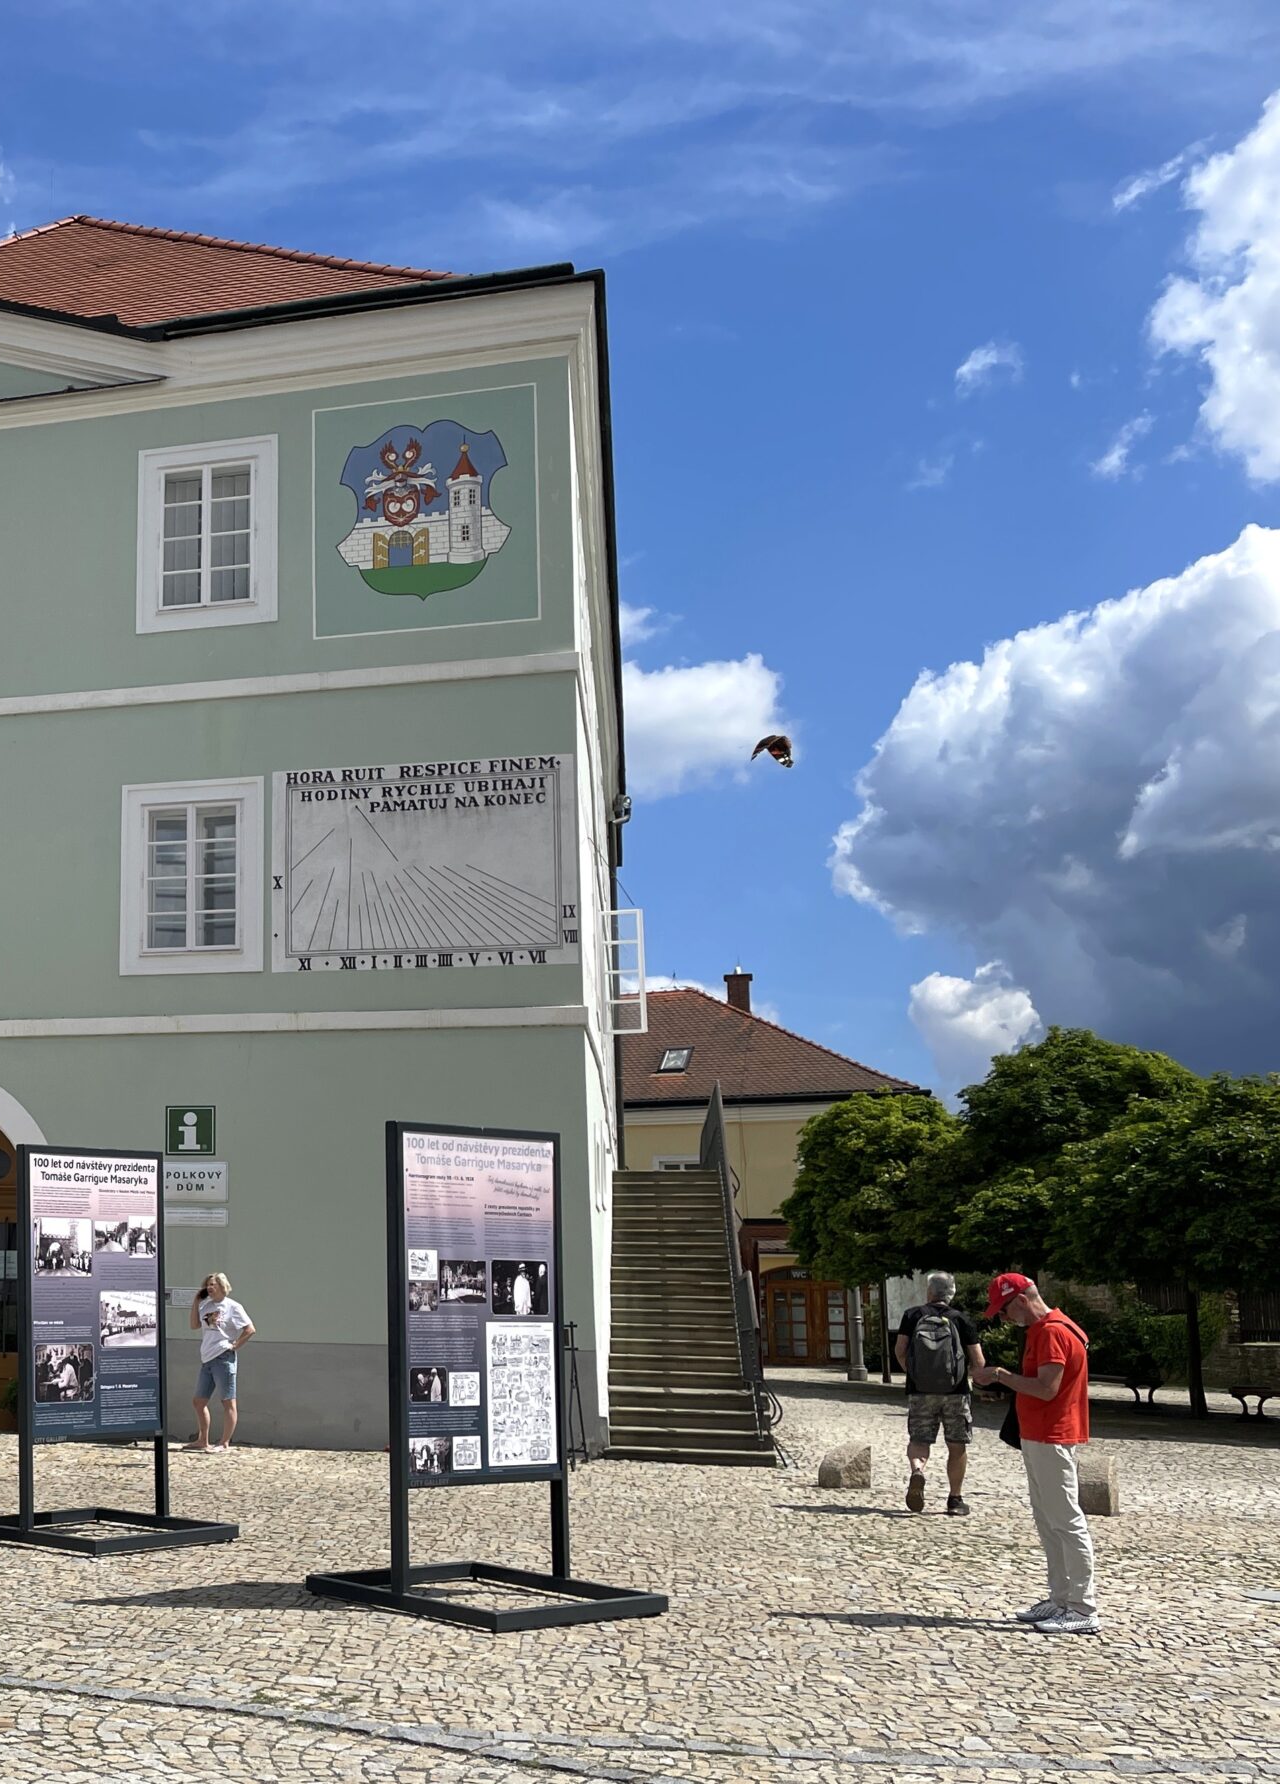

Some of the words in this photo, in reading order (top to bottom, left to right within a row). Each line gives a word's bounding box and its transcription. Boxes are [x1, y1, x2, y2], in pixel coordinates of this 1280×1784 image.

[286, 771, 335, 785] HORA
[341, 767, 385, 782] RUIT
[399, 760, 481, 779] RESPICE
[300, 787, 373, 802] HODINY
[381, 782, 455, 798] RYCHLE
[369, 797, 448, 813] PAMATUJ
[454, 796, 480, 808] NA
[483, 792, 546, 807] KONEC
[272, 875, 283, 890] X
[562, 904, 576, 918] IX
[562, 929, 579, 943] VIII
[298, 958, 312, 971] XI
[339, 956, 357, 970] XII
[393, 955, 403, 968] II
[414, 954, 428, 968] III
[437, 953, 453, 967] IIII
[468, 952, 480, 966] V
[498, 951, 514, 965] VI
[528, 950, 547, 964] VII
[406, 1137, 425, 1149] 100
[428, 1138, 440, 1150] let
[33, 1158, 49, 1168] 100
[51, 1160, 62, 1168] let
[63, 1160, 74, 1169] od
[114, 1163, 156, 1173] prezidenta
[40, 1171, 72, 1181] Tomáše
[73, 1173, 109, 1185] Garrigue
[110, 1175, 149, 1186] Masaryka
[166, 1171, 222, 1180] POLKOVÝ
[176, 1182, 205, 1191] DŮM
[791, 1271, 807, 1279] WC
